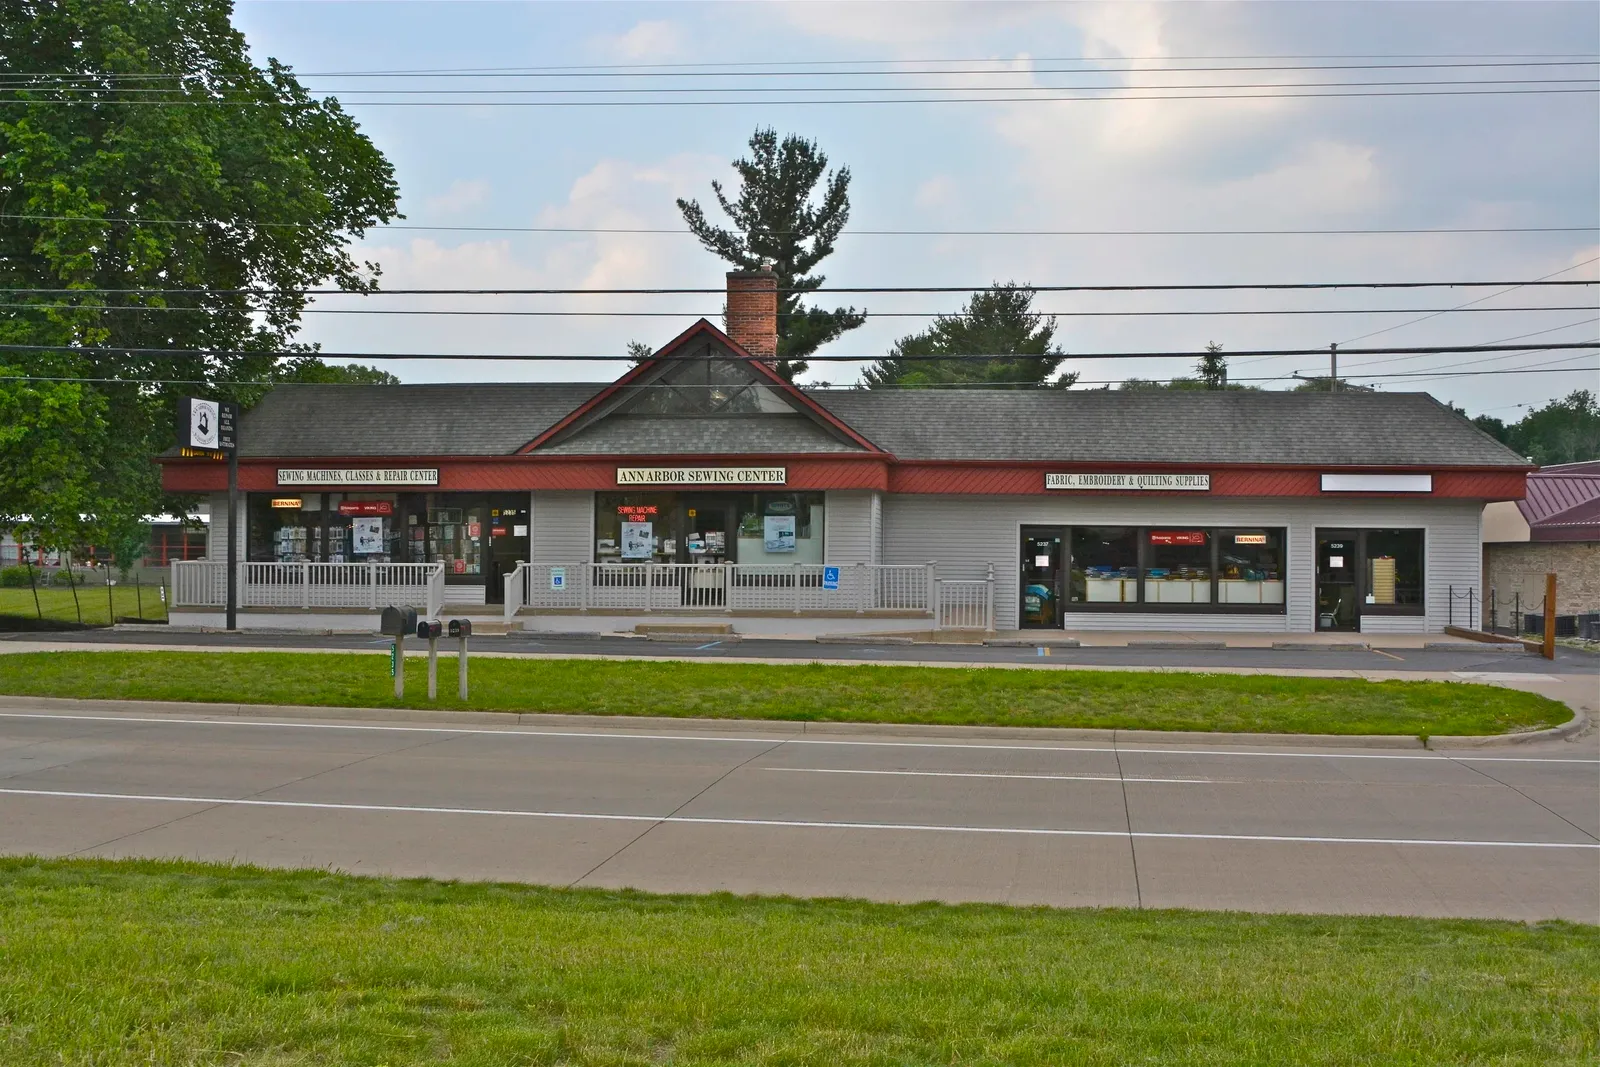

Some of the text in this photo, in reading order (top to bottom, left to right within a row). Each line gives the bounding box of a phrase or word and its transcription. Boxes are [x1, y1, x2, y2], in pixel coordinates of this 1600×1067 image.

[278, 470, 437, 483] SEWING MACHINES, CLASSES & REPAIR CENTER
[620, 470, 784, 482] ANN ARBOR SEWING CENTER
[1047, 475, 1209, 487] FABRIC, EMBROIDERY & QUILTING SUPPLIES
[617, 506, 658, 514] SEWING MACHINE
[628, 514, 646, 522] REPAIR
